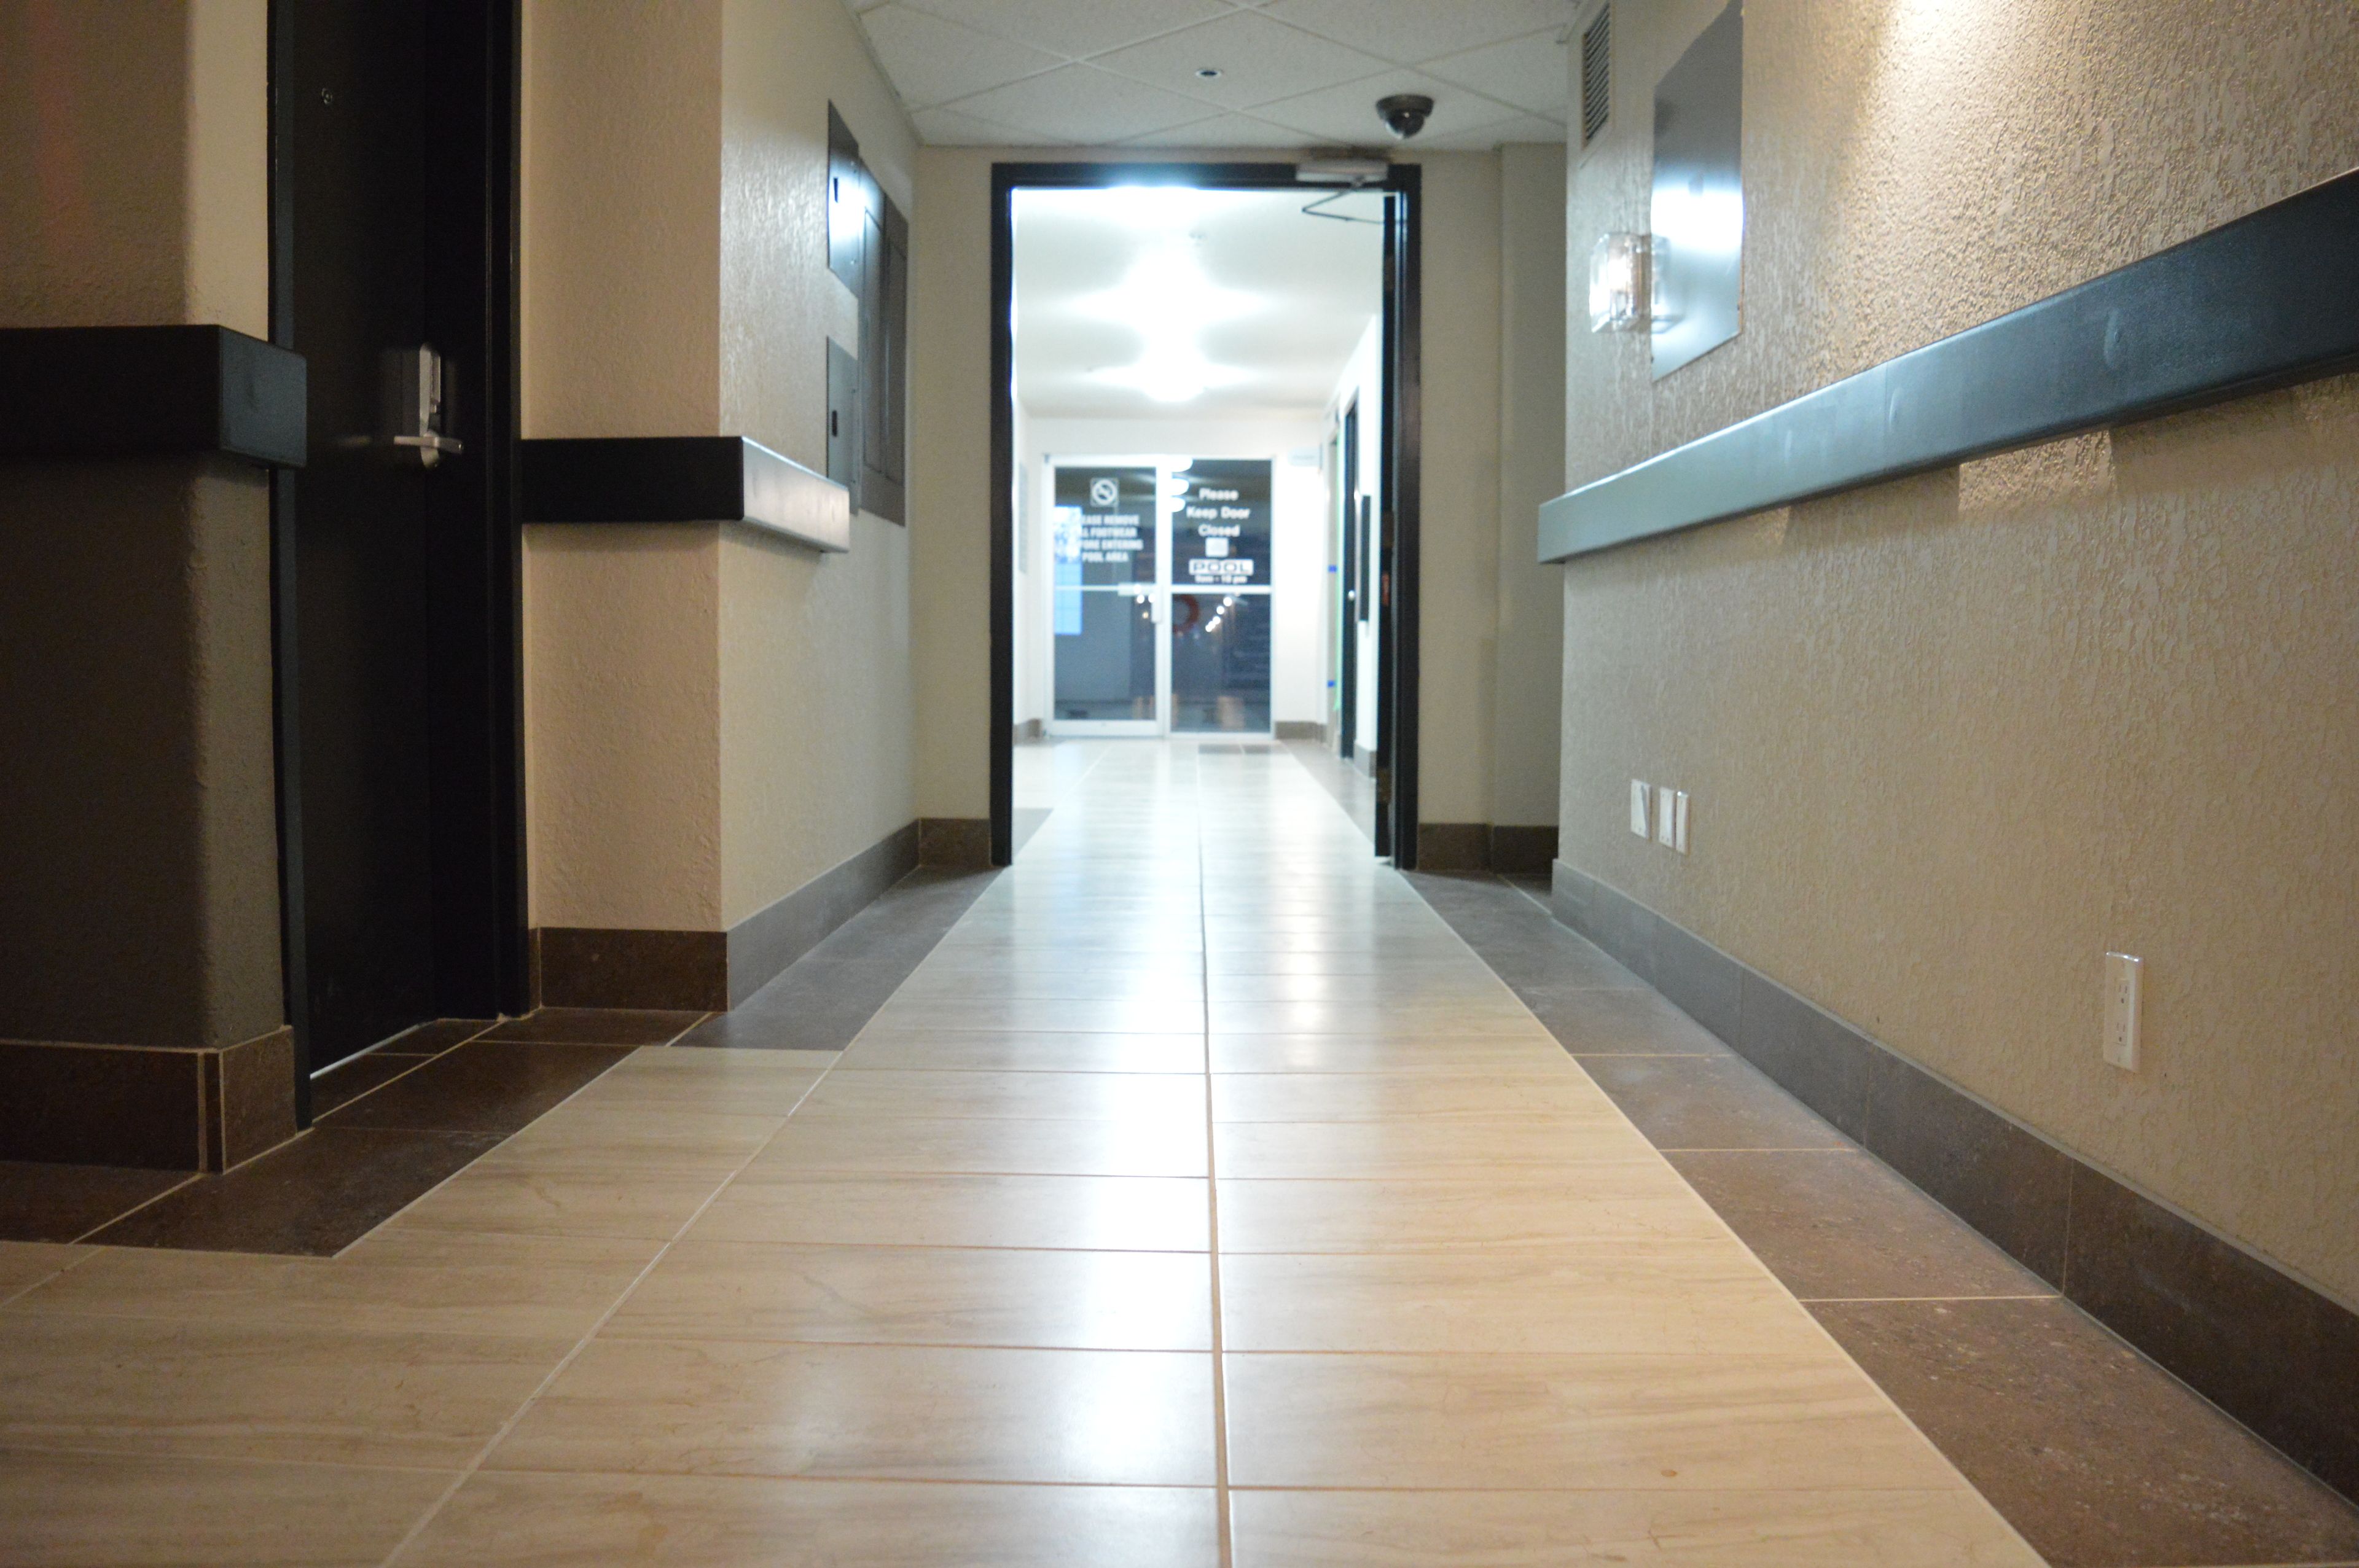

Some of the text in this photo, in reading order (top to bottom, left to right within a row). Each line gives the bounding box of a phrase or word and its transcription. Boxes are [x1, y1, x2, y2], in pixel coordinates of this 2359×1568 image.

[1199, 488, 1239, 501] Please
[1186, 506, 1251, 520] Keep Door
[1199, 525, 1240, 537] Closed
[1193, 561, 1250, 571] POOL
